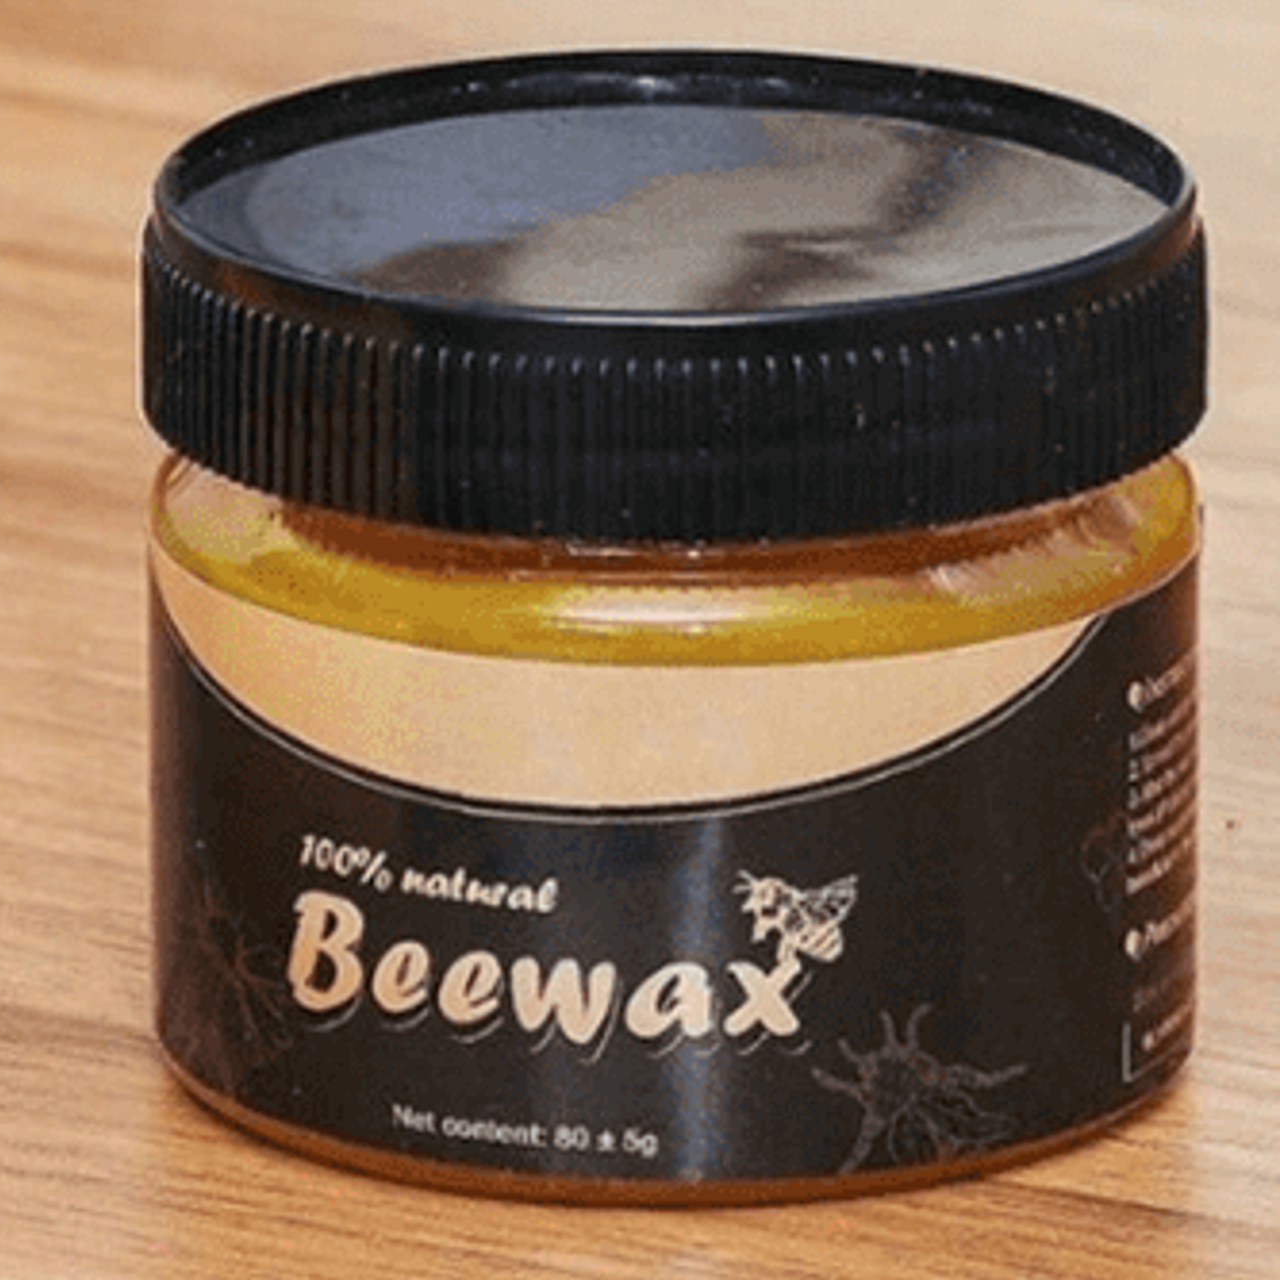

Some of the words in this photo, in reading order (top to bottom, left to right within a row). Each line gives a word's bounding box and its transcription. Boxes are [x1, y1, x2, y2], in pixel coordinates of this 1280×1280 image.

[299, 835, 392, 891] 100%
[401, 867, 559, 913] natural
[288, 890, 802, 1045] Beewax
[393, 1104, 436, 1132] Net
[441, 1116, 547, 1148] content:
[554, 1124, 589, 1150] 80
[622, 1127, 659, 1159] 5g
